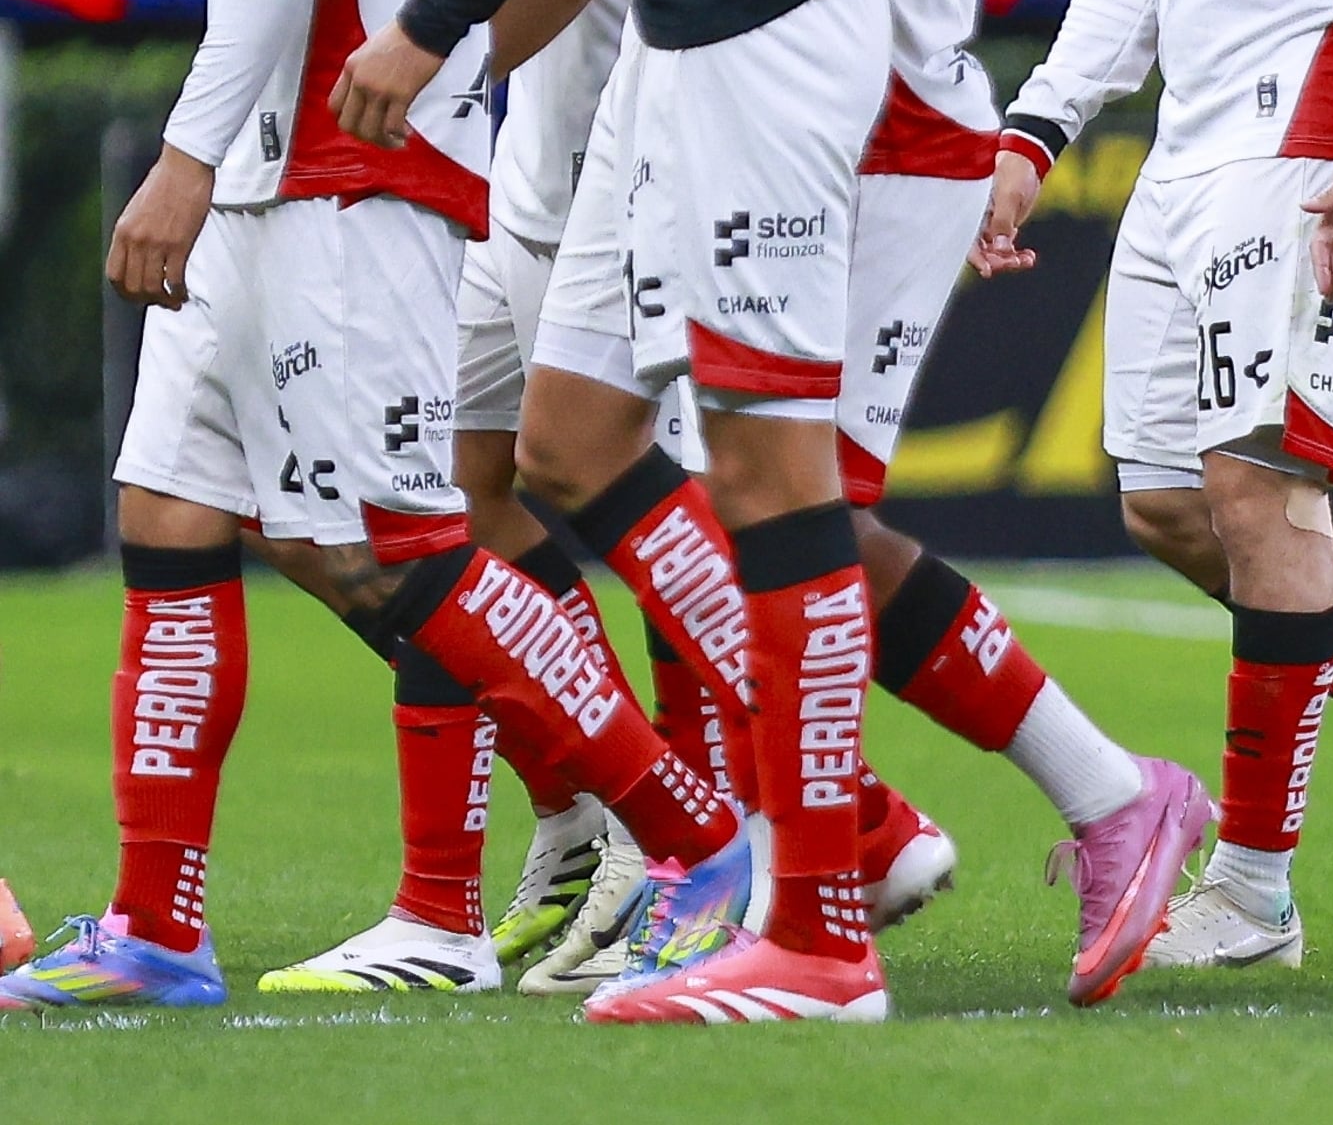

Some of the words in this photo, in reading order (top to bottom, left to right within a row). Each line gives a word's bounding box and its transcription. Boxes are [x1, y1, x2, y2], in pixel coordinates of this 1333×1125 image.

[757, 207, 826, 240] stori
[757, 242, 826, 259] finanzas
[717, 296, 790, 314] CHARLY
[392, 471, 450, 493] CHARL
[464, 558, 621, 738] PERDURA
[130, 594, 218, 778] PERDURA
[800, 580, 867, 809] PERDURA
